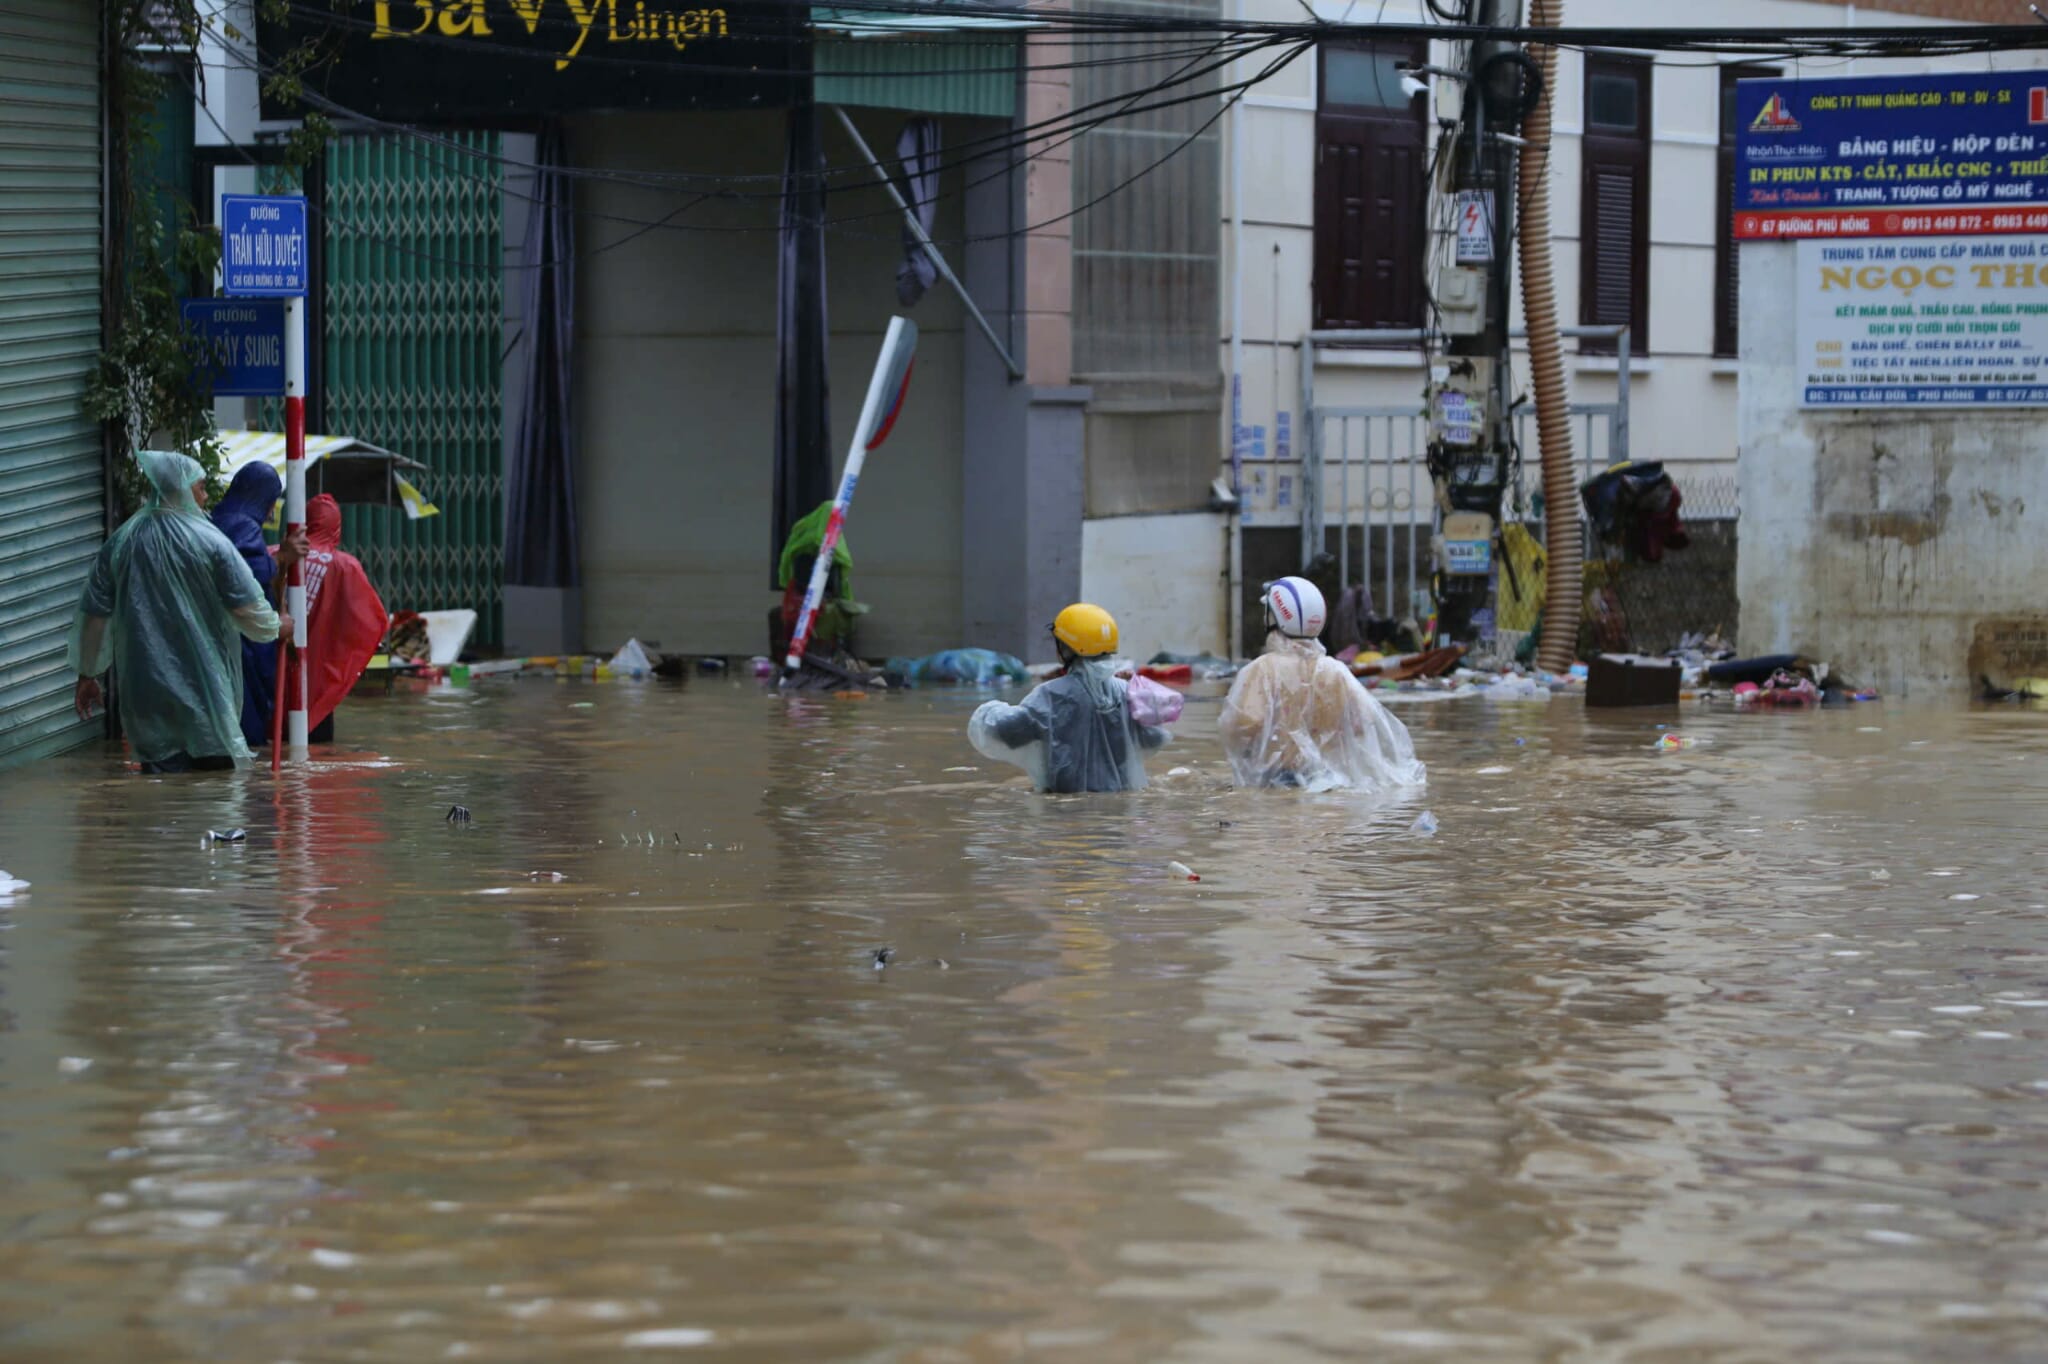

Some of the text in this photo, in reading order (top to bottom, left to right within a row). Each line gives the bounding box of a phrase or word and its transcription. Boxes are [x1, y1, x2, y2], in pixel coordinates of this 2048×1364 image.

[1810, 94, 1838, 110] CÔNG
[1841, 95, 1853, 109] TY
[1855, 94, 1882, 108] TNHH
[1950, 91, 1966, 105] TM
[1838, 132, 2035, 157] BẢNG HIỆU HỘP ĐÈN
[1750, 167, 1768, 182] IN
[1772, 166, 1817, 182] PHUN
[1820, 165, 1852, 181] KTS
[1905, 156, 1953, 179] KHẮC
[1957, 162, 1992, 177] CNC
[1891, 184, 1938, 202] TƯỢNG
[1994, 180, 2034, 199] NGHỆ
[250, 204, 280, 221] ĐƯỜNG
[1762, 219, 1775, 233] 67
[1902, 216, 1931, 231] 0913
[230, 222, 302, 272] TRẦN HỮU DUYỆT
[1822, 247, 1864, 260] TRUNG
[1868, 244, 1896, 259] TÂM
[1900, 245, 1936, 259] CUNG
[1941, 241, 1967, 257] CẤP
[1819, 263, 2048, 297] NGỌC TH
[214, 306, 257, 323] ĐƯỜNG
[244, 334, 280, 368] SUNG
